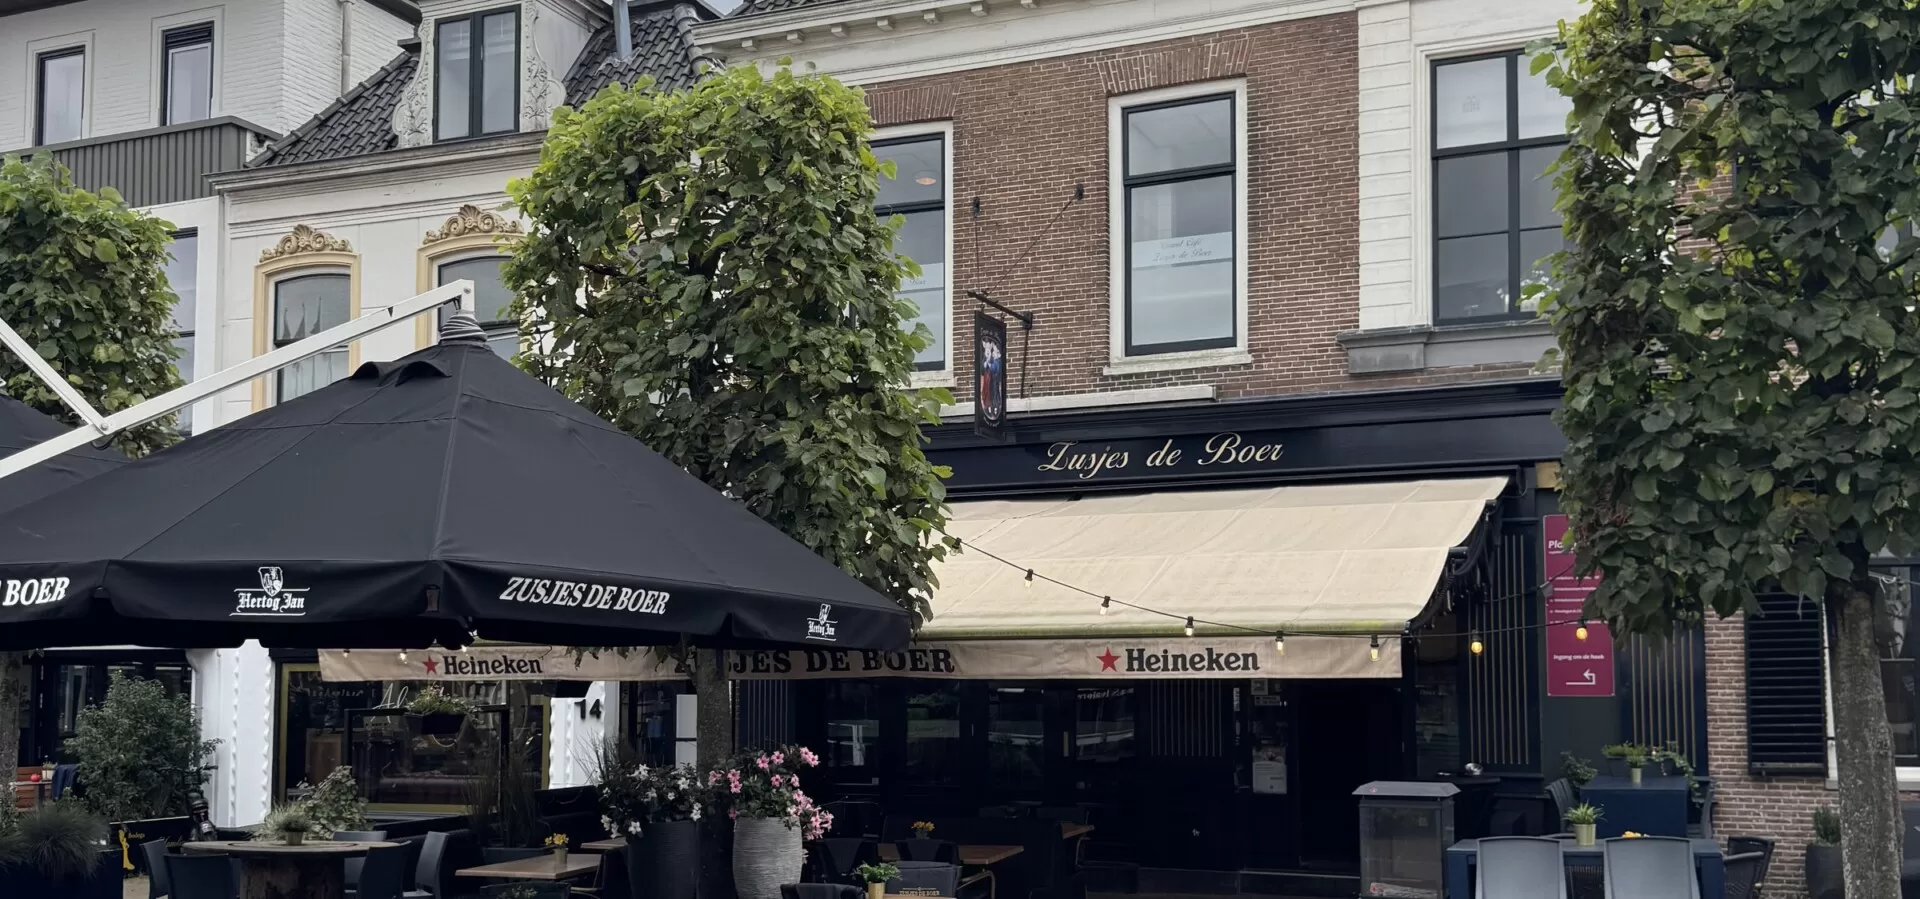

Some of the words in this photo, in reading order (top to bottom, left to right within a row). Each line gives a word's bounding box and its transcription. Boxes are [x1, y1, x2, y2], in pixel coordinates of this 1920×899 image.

[1037, 440, 1129, 479] Zusjes
[1146, 439, 1182, 467] de
[1198, 431, 1284, 465] Boer
[2, 577, 70, 607] BOER
[236, 592, 280, 613] Hertog
[280, 593, 305, 612] Jan
[499, 577, 587, 607] ZUSJES
[582, 584, 618, 610] DE
[613, 587, 671, 615] BOER
[443, 655, 543, 675] Heineken
[806, 650, 850, 672] DE
[862, 648, 955, 673] BOER
[1125, 648, 1260, 673] Heineken
[575, 699, 602, 720] 14
